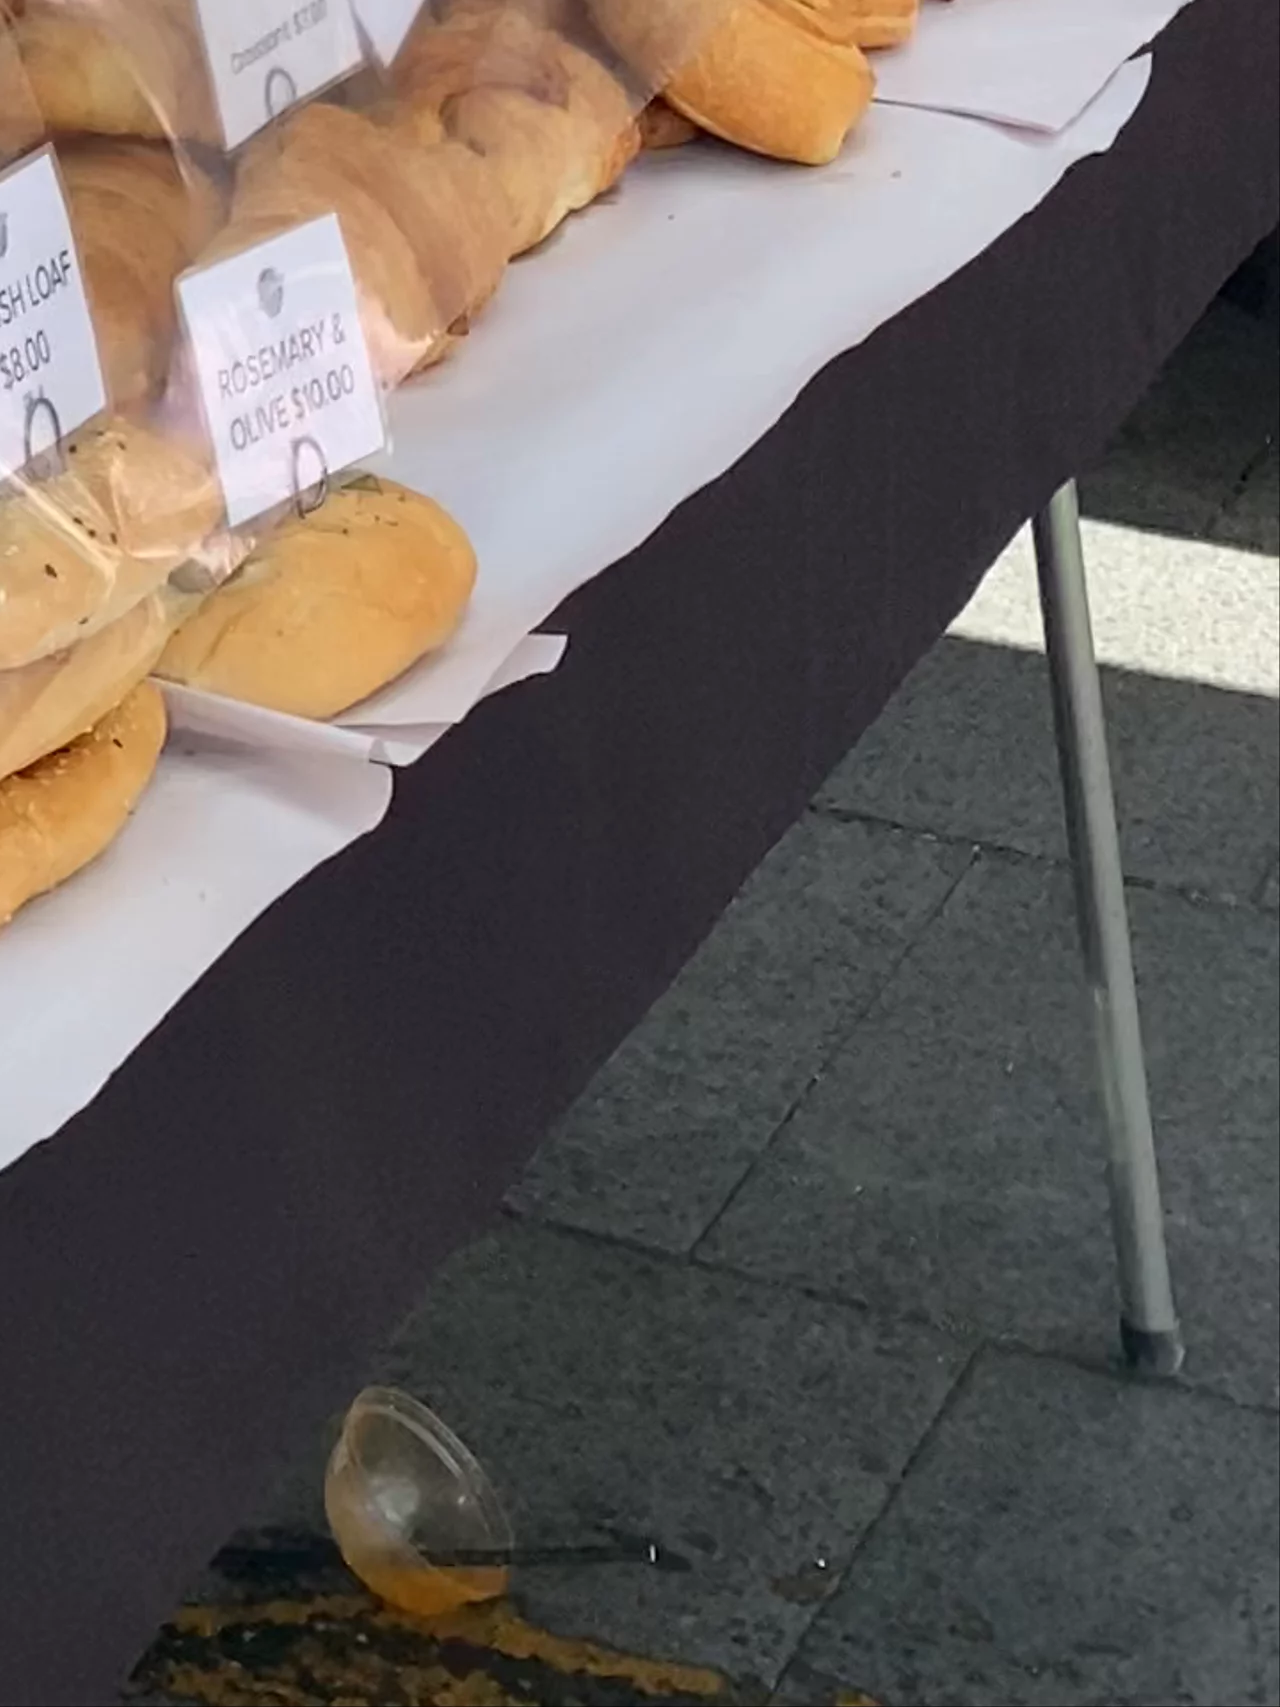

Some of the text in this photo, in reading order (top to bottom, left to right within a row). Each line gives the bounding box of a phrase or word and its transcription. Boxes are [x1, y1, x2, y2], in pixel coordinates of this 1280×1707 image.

[26, 249, 72, 308] LOAF
[217, 312, 346, 400] ROSEMARY &
[229, 363, 355, 452] OLIVE $10.00
